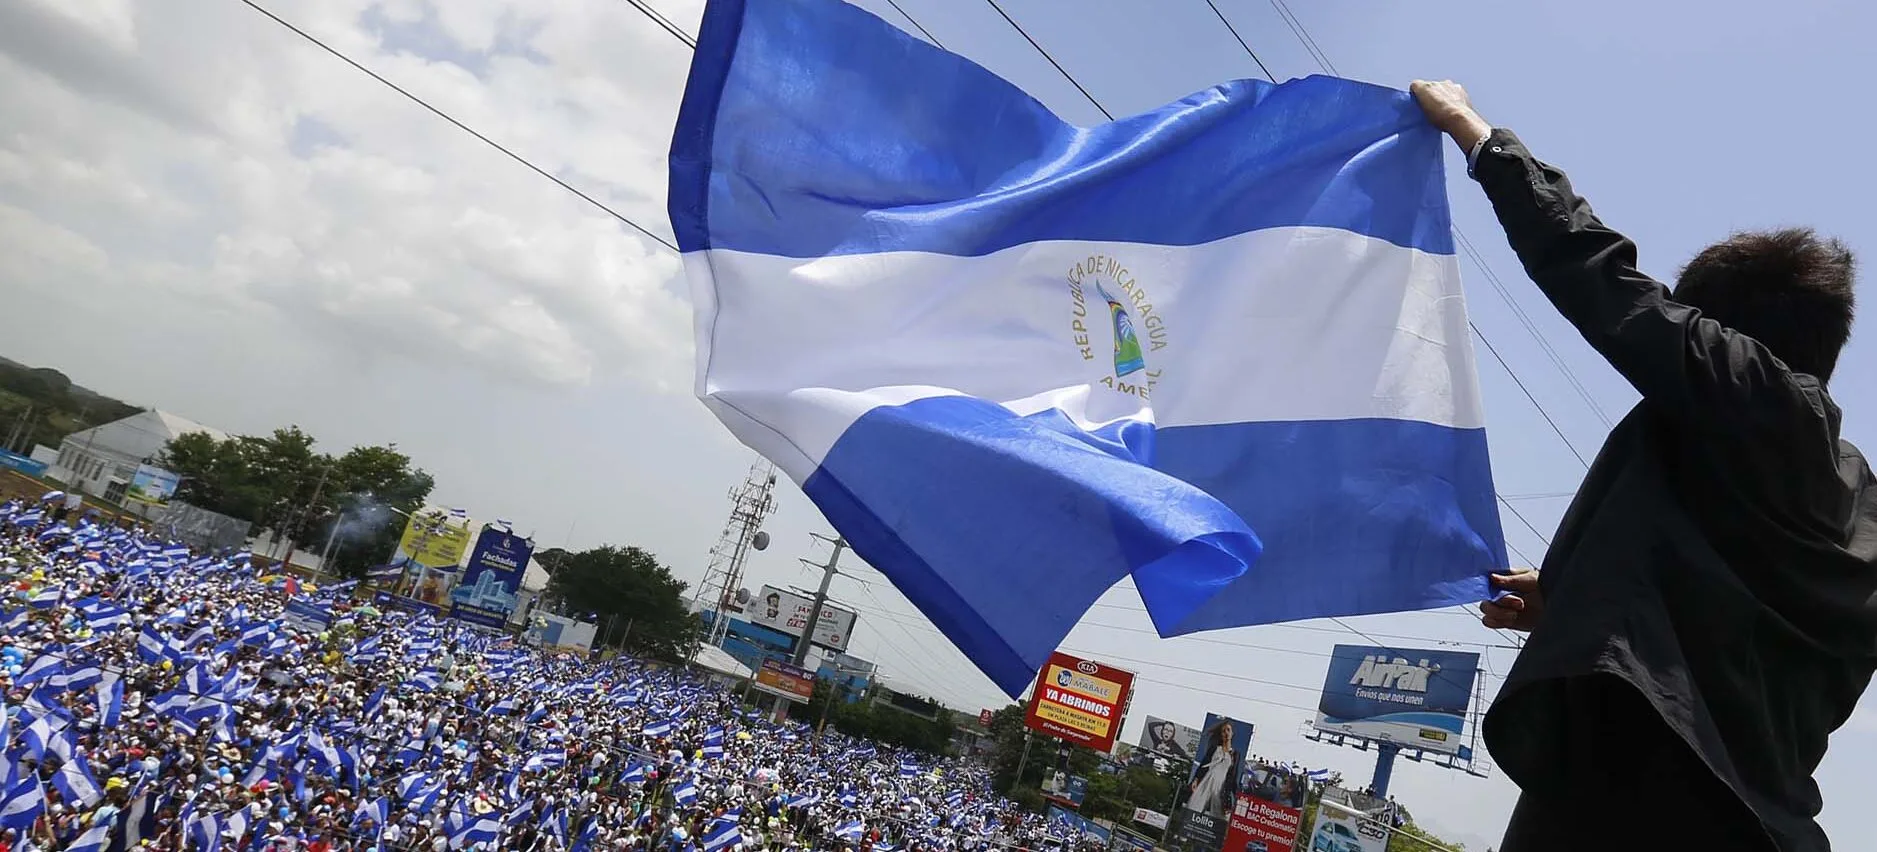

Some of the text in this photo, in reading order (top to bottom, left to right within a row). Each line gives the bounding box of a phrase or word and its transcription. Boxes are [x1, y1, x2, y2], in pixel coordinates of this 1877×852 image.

[1087, 255, 1104, 274] DE
[1105, 257, 1168, 352] NICARAGUA
[482, 551, 517, 567] Fachadas
[1081, 662, 1095, 672] KIA
[1350, 655, 1441, 692] AirPak
[1046, 688, 1111, 717] YA ABRIMOS
[1378, 692, 1391, 704] que
[1391, 693, 1405, 703] nos
[1405, 695, 1424, 706] unen
[1191, 812, 1214, 828] Lolita
[1246, 811, 1296, 834] BAC Credomatic
[1249, 801, 1298, 825] La Regalona
[1231, 818, 1257, 835] ¡Escoge
[1257, 828, 1265, 838] tu
[1265, 831, 1294, 847] premio!
